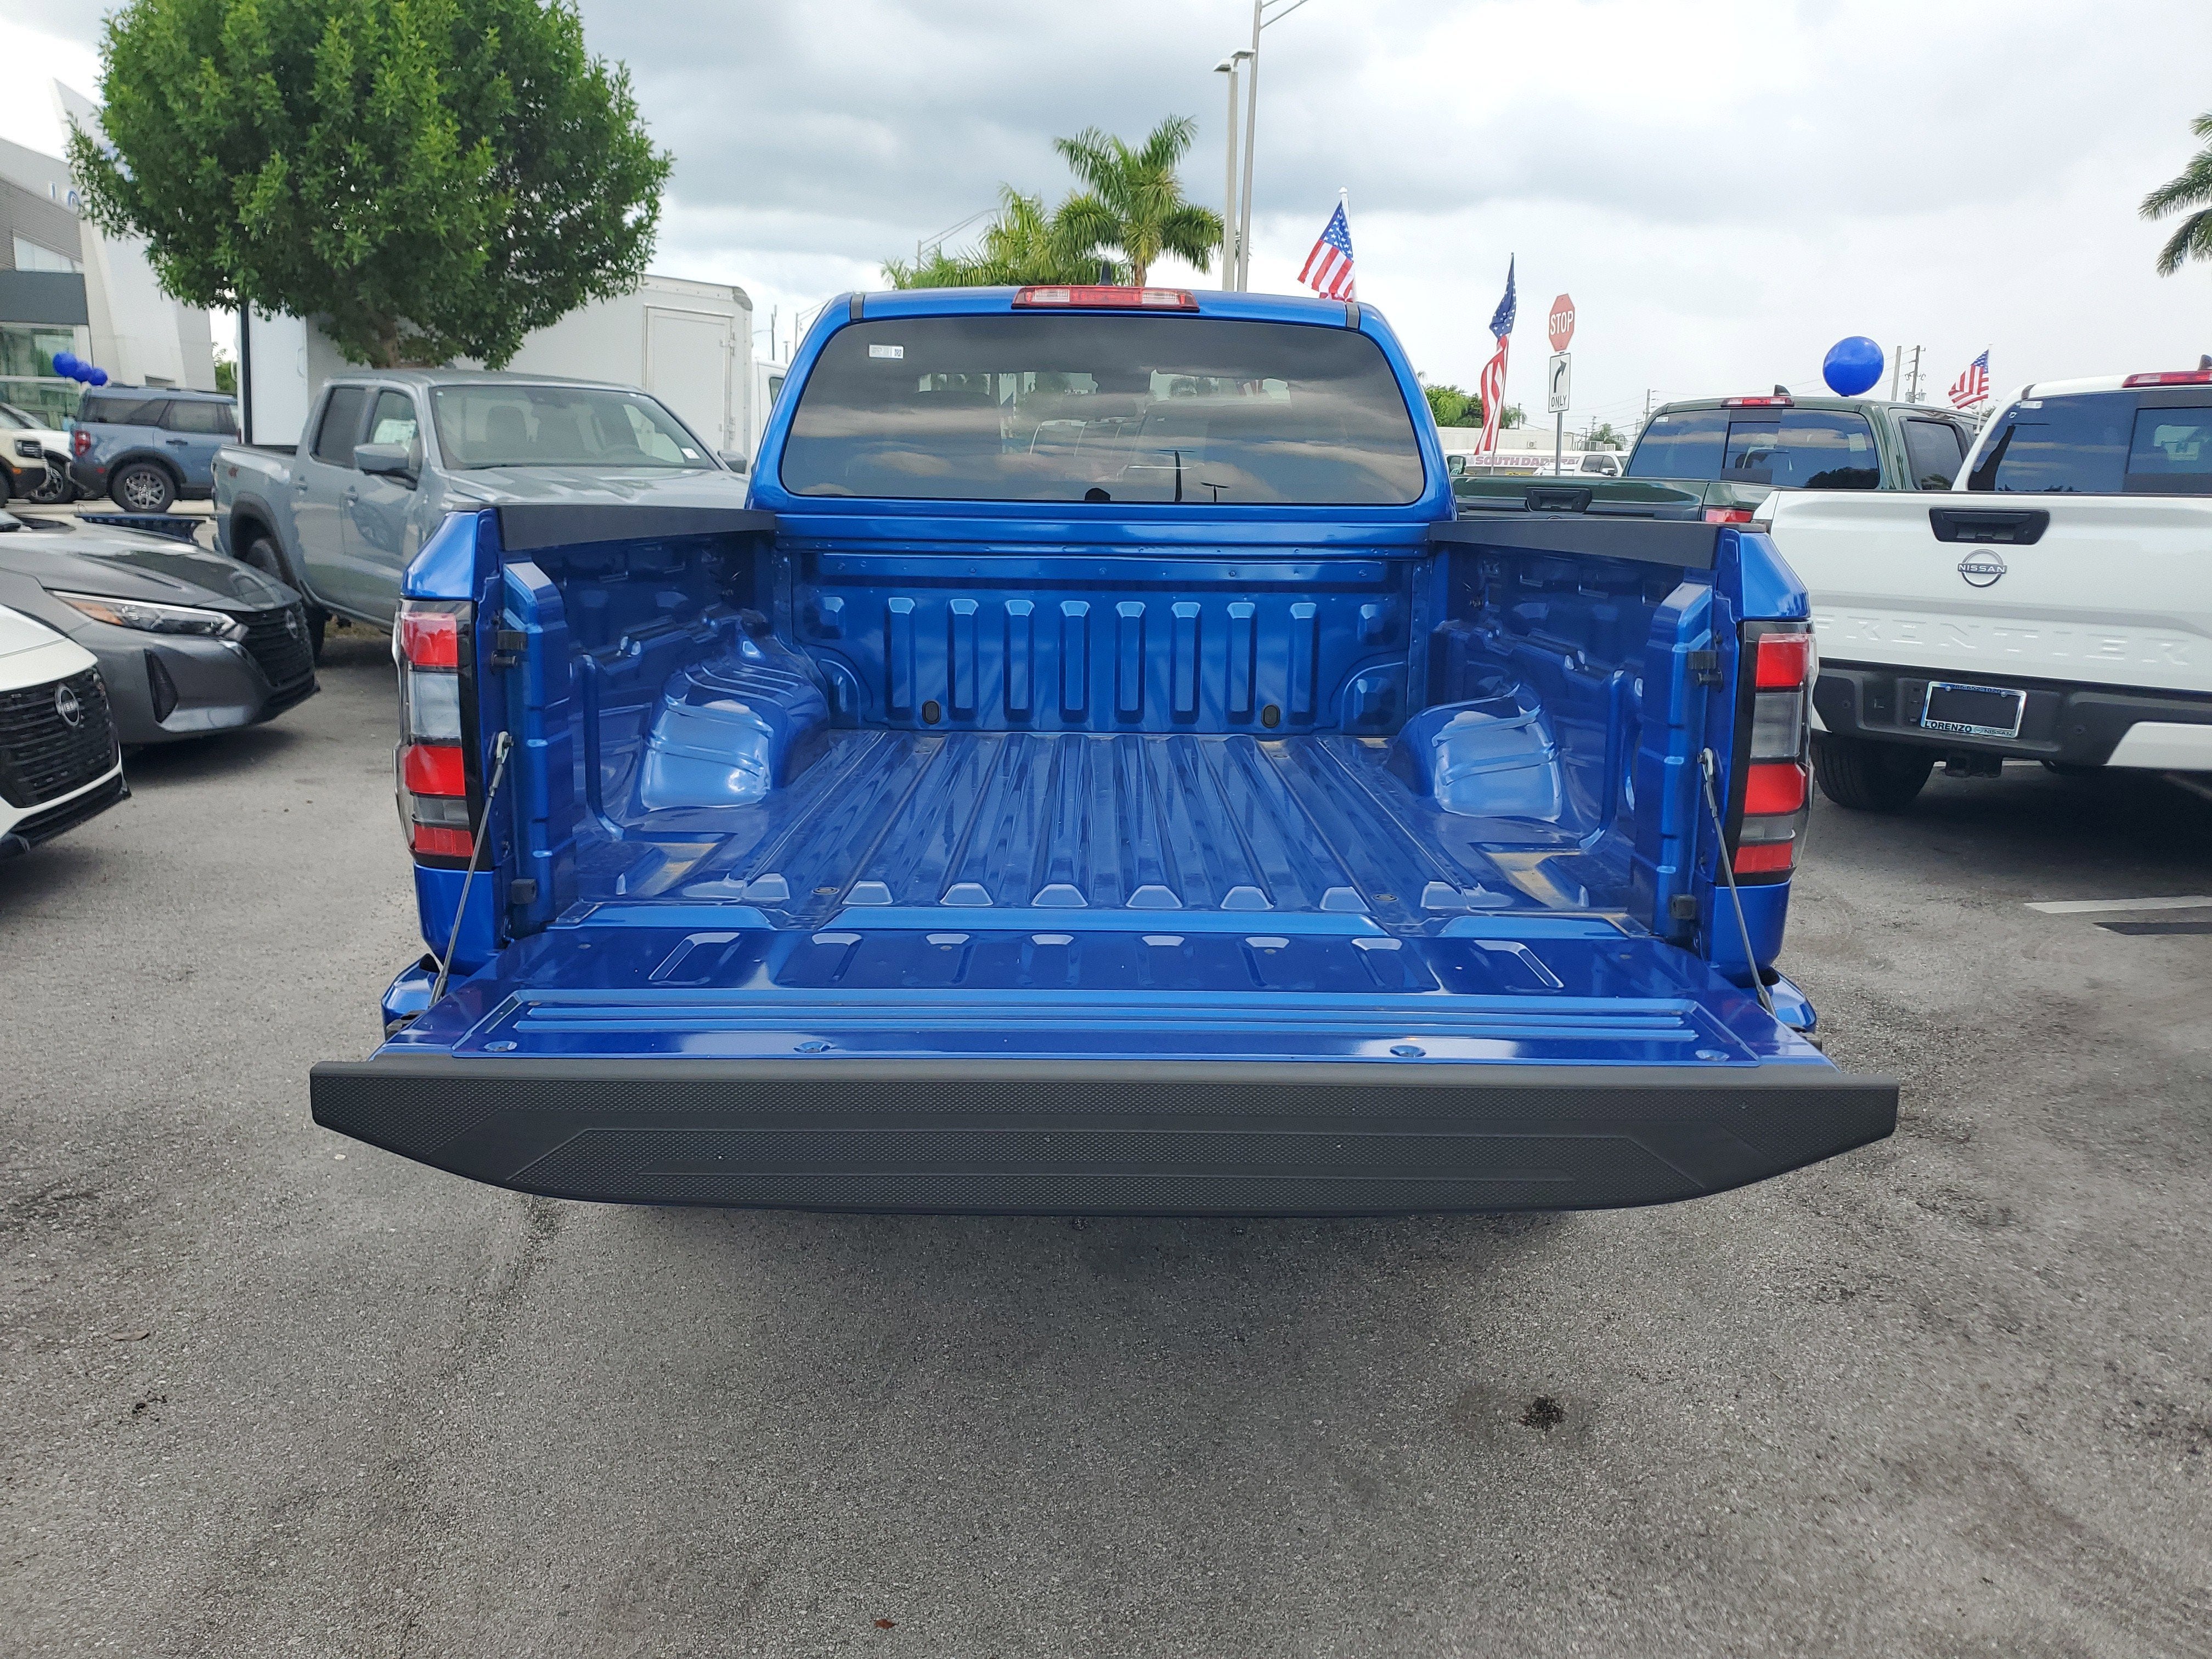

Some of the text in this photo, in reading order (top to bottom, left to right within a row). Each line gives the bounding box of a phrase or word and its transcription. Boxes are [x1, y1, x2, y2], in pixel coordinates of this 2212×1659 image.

[1550, 310, 1573, 335] STOP
[1551, 394, 1567, 408] ONLY
[1475, 456, 1520, 466] SOUTH
[1959, 564, 2005, 573] NISSAN
[1925, 720, 2013, 737] LORENZO NISSAN
